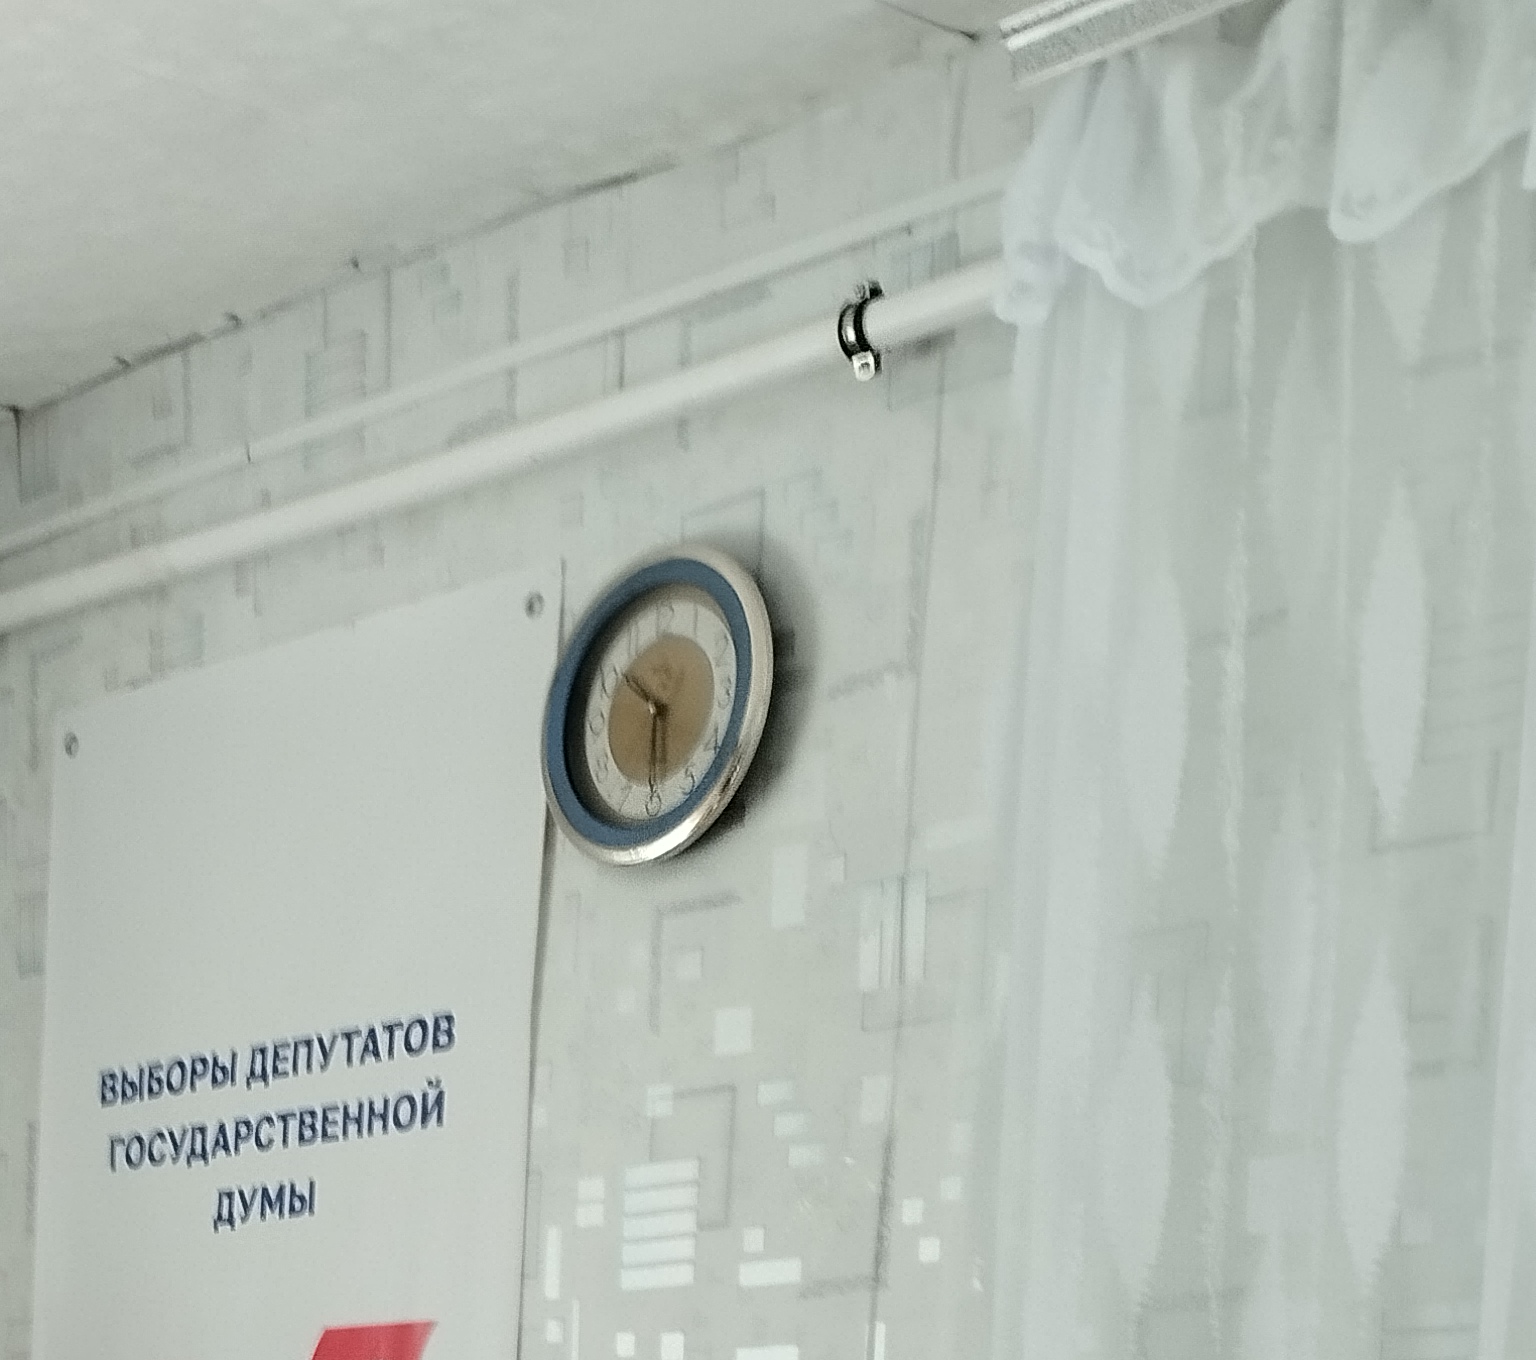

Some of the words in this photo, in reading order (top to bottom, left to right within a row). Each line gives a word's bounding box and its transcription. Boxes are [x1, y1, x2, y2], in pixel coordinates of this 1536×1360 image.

[99, 1050, 238, 1108] ВЫБОРЫ
[244, 1010, 457, 1089] ДЕПУТАТОВ
[108, 1077, 447, 1173] ГОСУДАРСТВЕННОЙ
[212, 1179, 317, 1233] ДУМЫ
